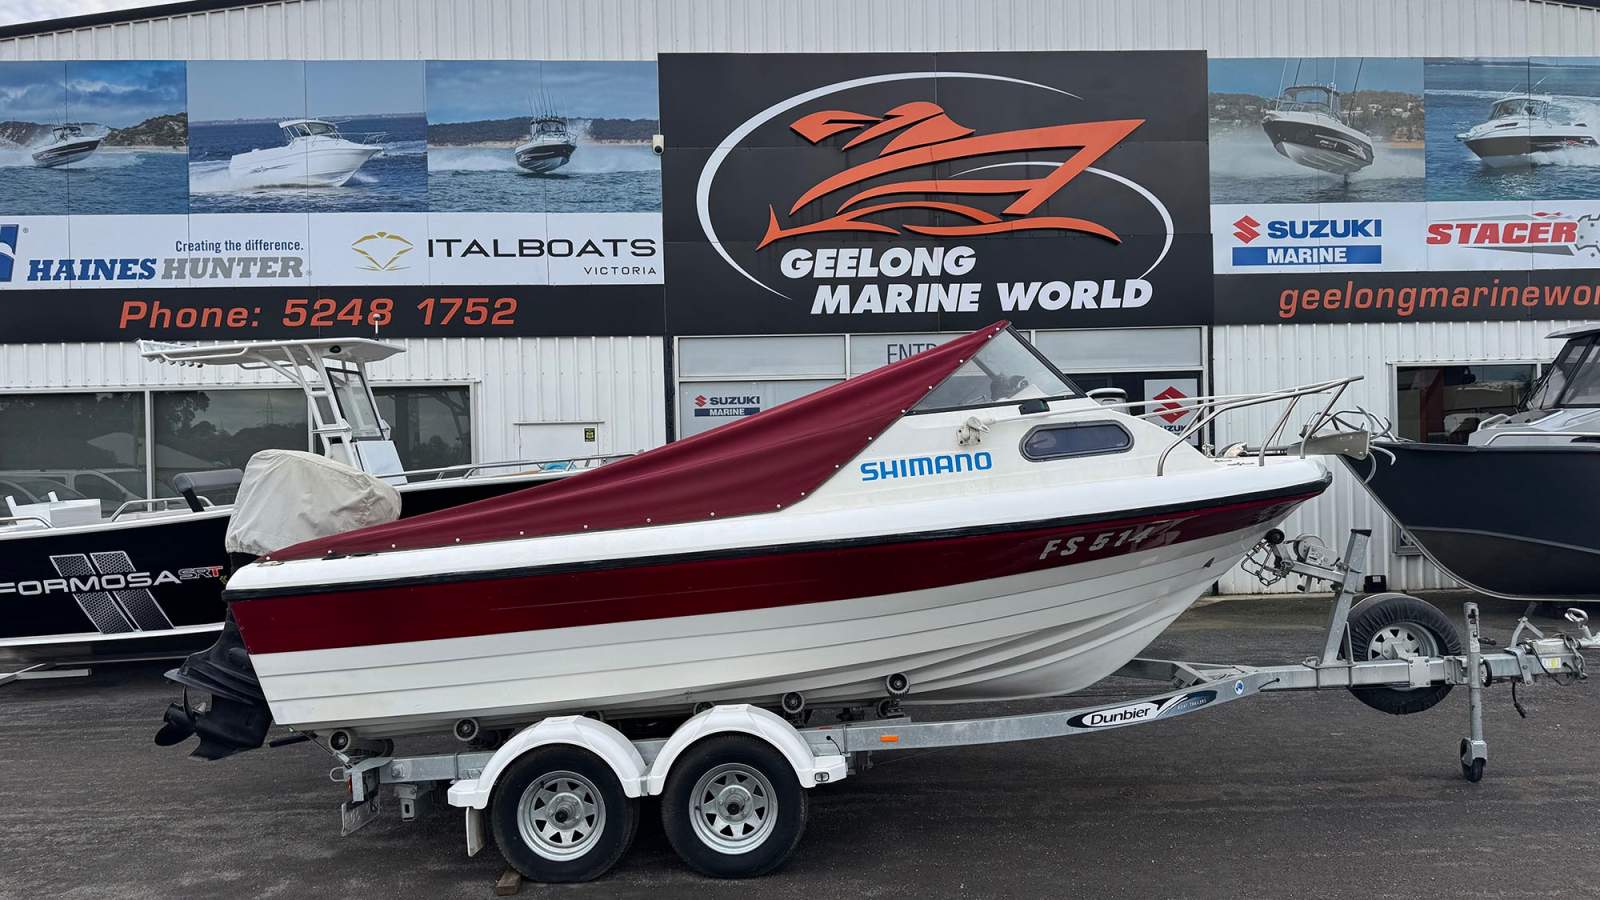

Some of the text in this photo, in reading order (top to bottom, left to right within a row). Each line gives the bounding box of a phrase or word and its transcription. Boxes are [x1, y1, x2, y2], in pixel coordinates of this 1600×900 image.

[1267, 219, 1382, 239] SUZUKI
[1426, 222, 1578, 245] STACER
[175, 239, 304, 253] Creating the difference.
[427, 238, 657, 258] ITALBOATS
[1267, 247, 1347, 264] MARINE
[27, 256, 303, 281] HAINES HUNTER
[584, 266, 657, 275] VICTORIA
[780, 246, 977, 279] GEELONG
[810, 279, 1153, 314] MARINE WORLD
[119, 297, 518, 329] Phone: 5248 1752
[887, 344, 937, 365] ENT
[709, 396, 760, 405] SUZUKI
[709, 408, 745, 417] MARINE
[860, 451, 992, 481] SHIMANO
[1039, 536, 1085, 560] FS
[0, 566, 224, 596] FORMOSA SRT
[1090, 708, 1151, 725] Dunbier
